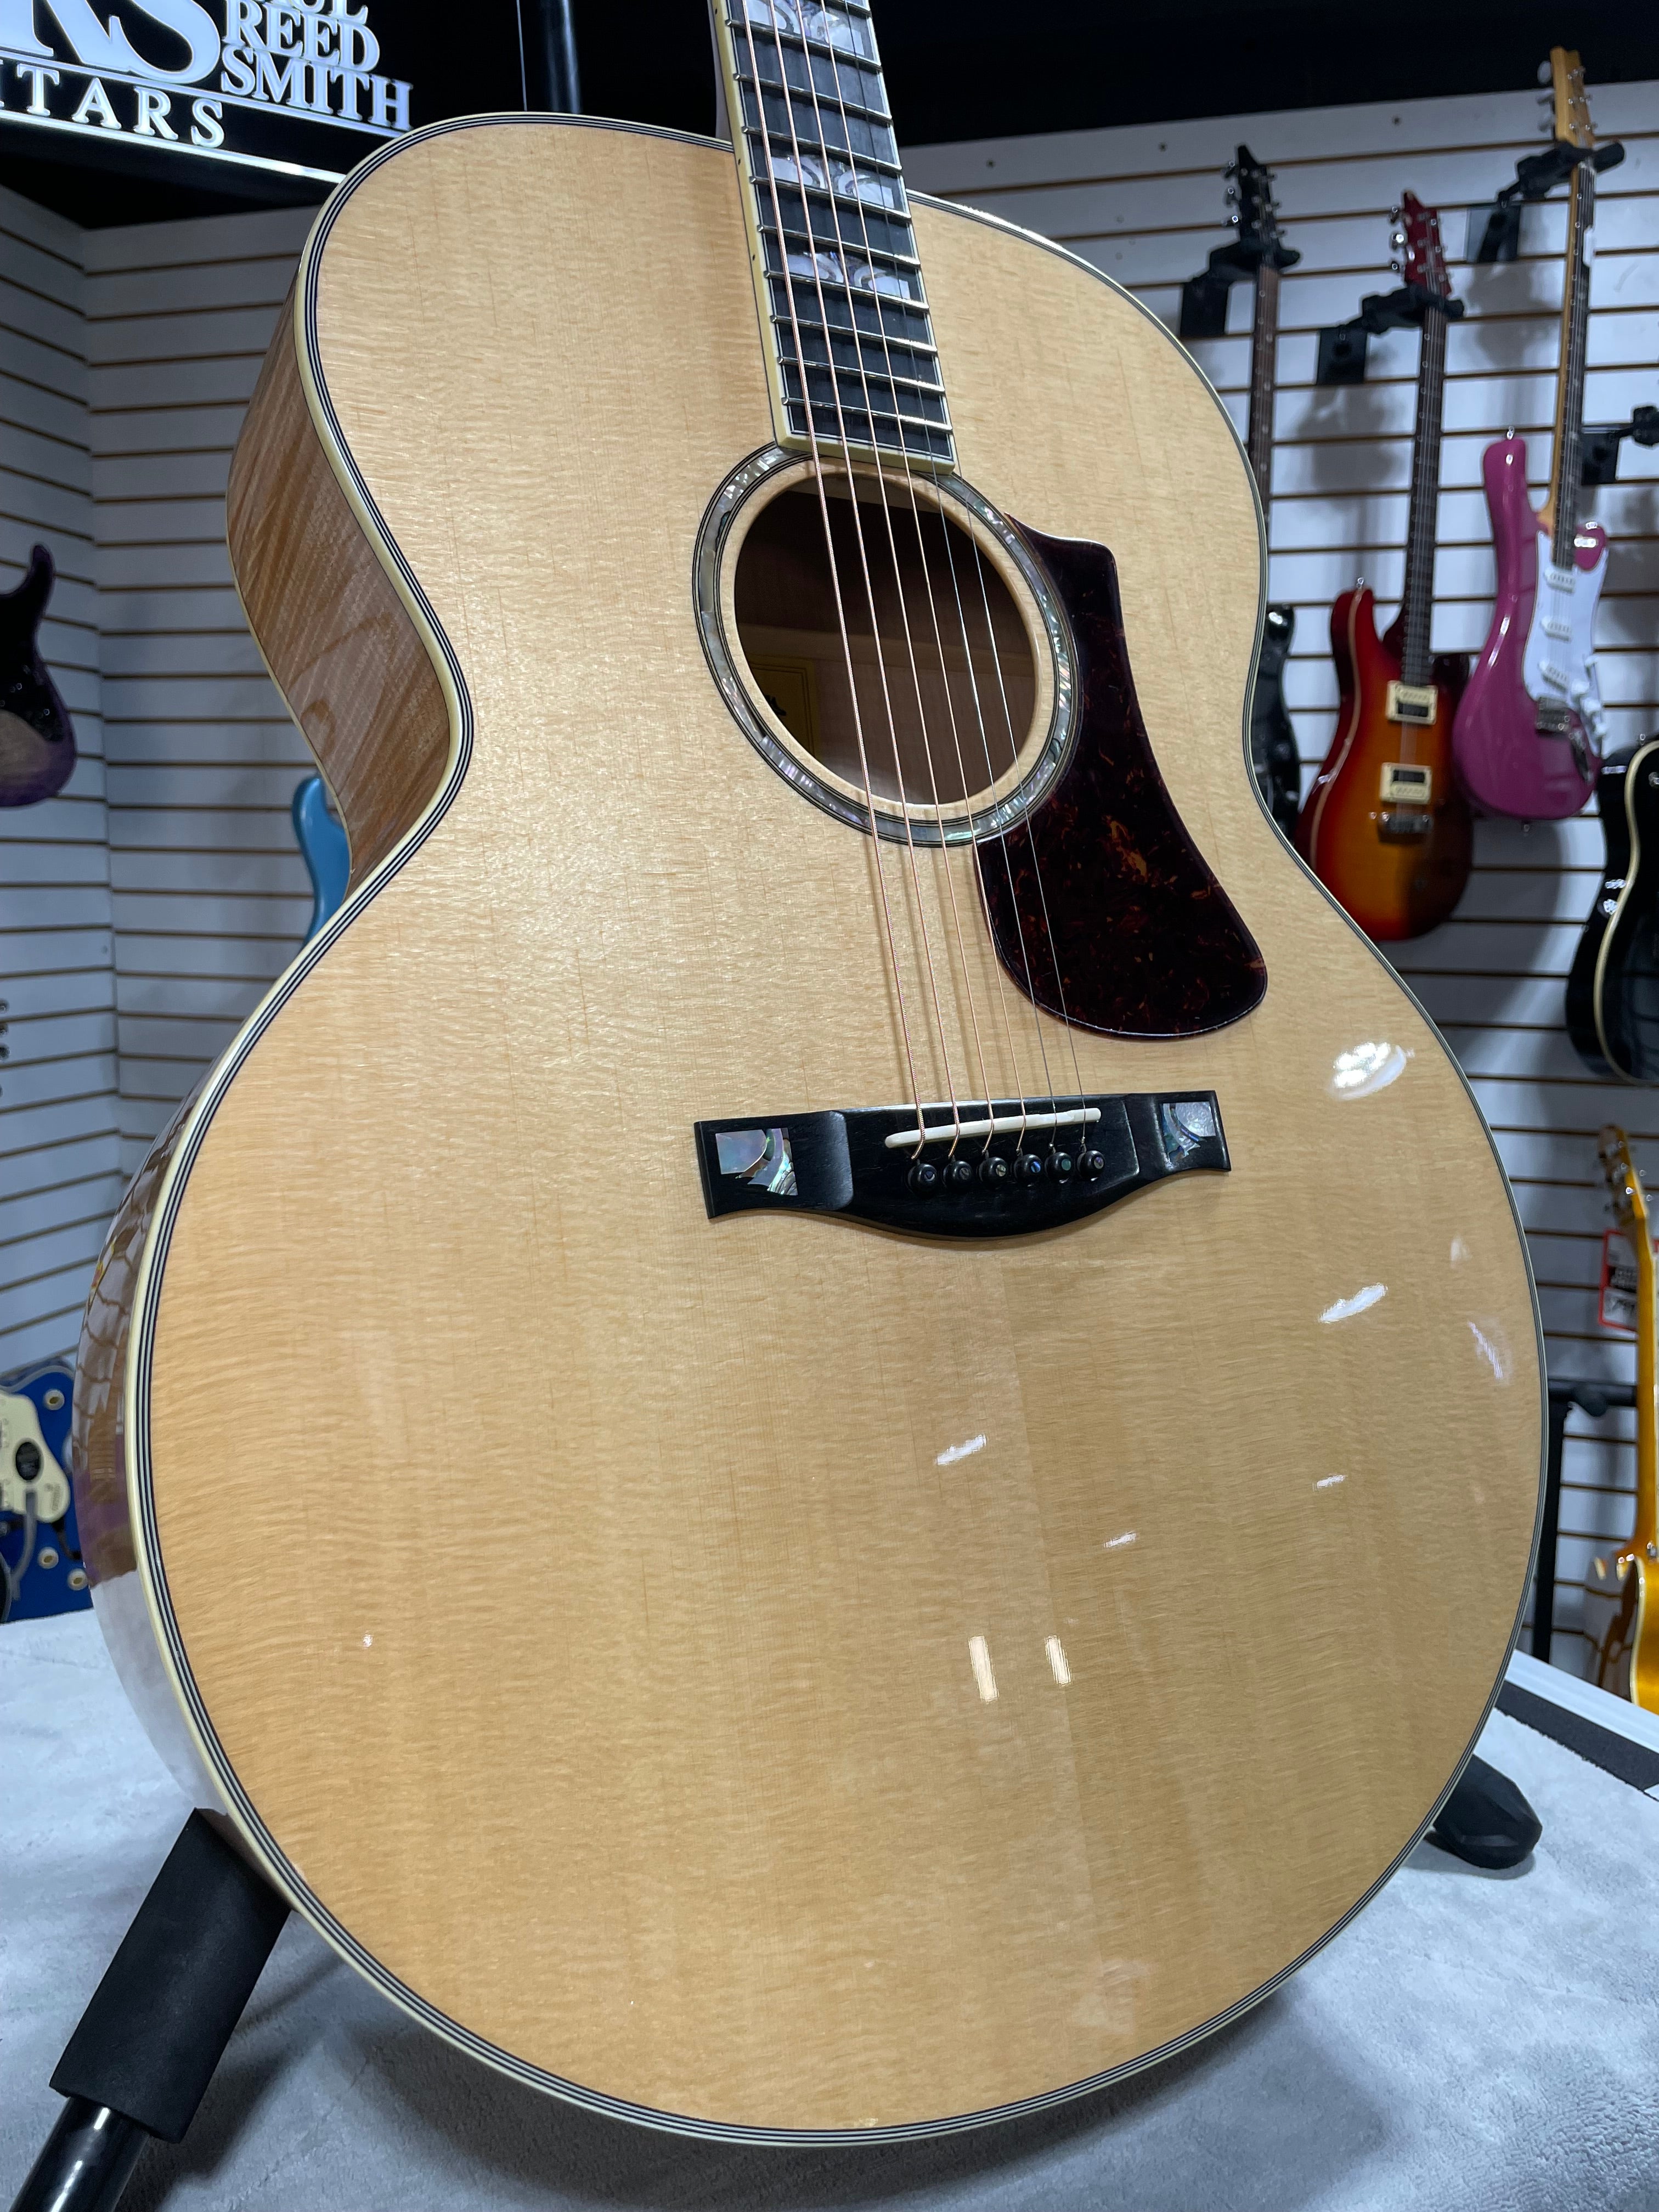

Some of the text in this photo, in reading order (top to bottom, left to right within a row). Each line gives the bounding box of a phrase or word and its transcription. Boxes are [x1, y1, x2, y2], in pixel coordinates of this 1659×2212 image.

[222, 0, 380, 72] REED
[0, 60, 224, 148] TARS
[222, 44, 413, 131] SMITH
